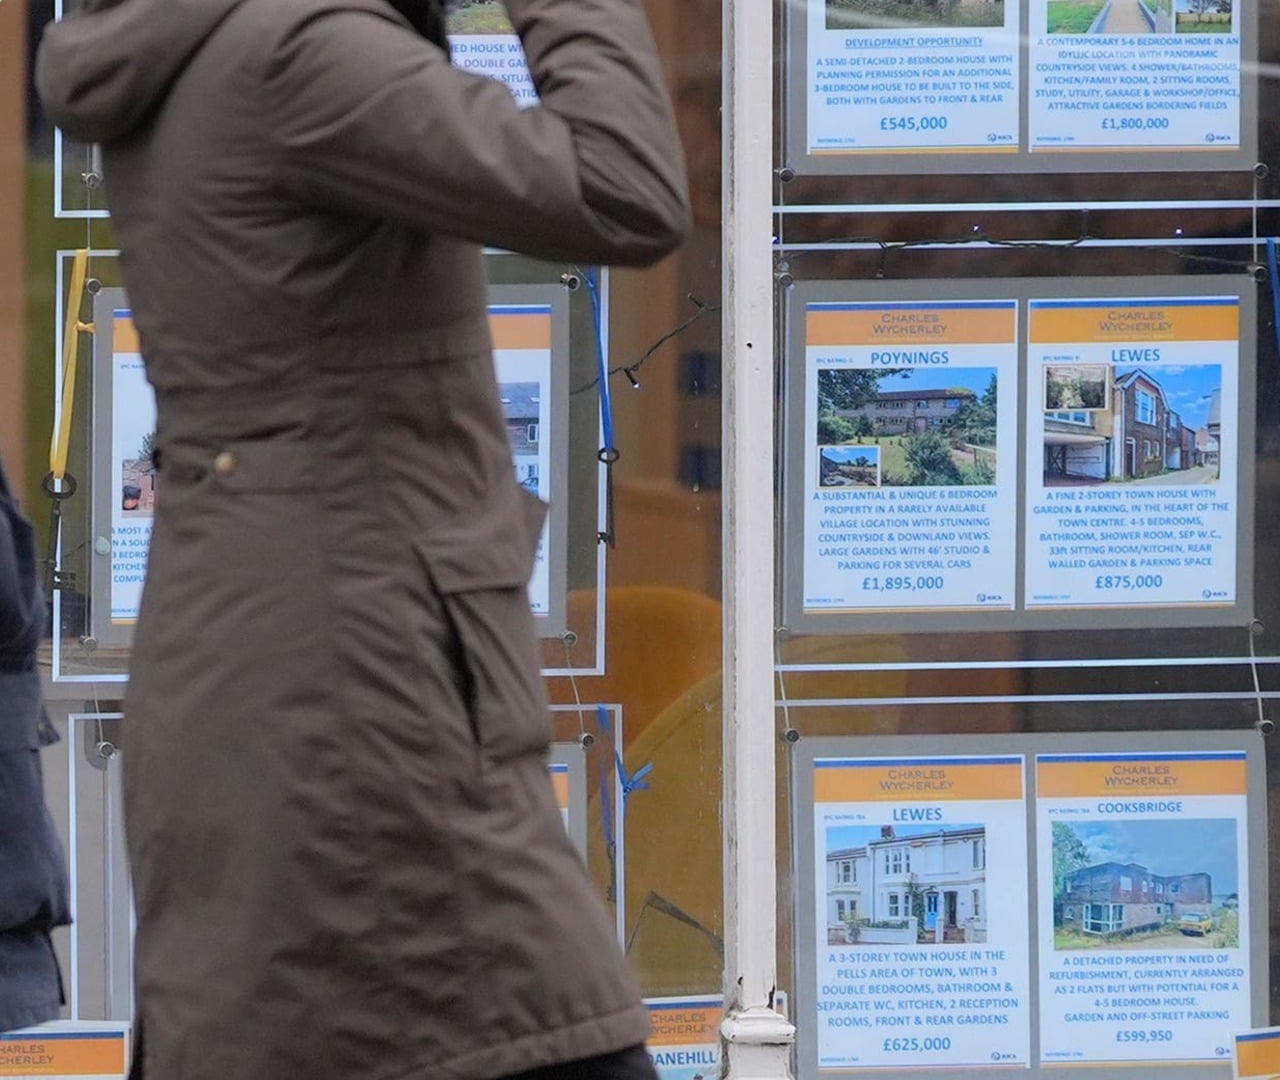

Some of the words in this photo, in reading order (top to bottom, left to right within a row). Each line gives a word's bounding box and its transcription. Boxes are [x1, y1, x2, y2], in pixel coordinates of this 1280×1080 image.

[845, 38, 914, 48] DEVELOPMENT
[917, 37, 982, 46] OPPORTUNITY
[880, 116, 947, 132] £545,000
[1102, 118, 1169, 130] £1,800,000
[882, 313, 938, 323] CHARLES
[1108, 311, 1164, 320] CHARLES
[873, 325, 947, 335] WYCHERLEY
[1100, 321, 1172, 332] WYCHERLEY
[871, 352, 949, 365] POYNINGS
[1112, 349, 1160, 362] LEWES
[824, 506, 872, 514] PROPERTY
[888, 505, 895, 513] A
[897, 504, 932, 513] RARELY
[935, 504, 986, 512] AVAILABLE
[863, 576, 943, 591] £1,895,000
[1096, 575, 1162, 590] £875,000
[1098, 802, 1182, 814] COOKSBRIDGE
[893, 808, 942, 821] LEWES
[829, 954, 836, 962] A
[839, 952, 890, 962] 3-STOREY
[894, 952, 928, 962] TOWN
[930, 951, 967, 962] HOUSE
[970, 951, 982, 960] IN
[985, 950, 1005, 960] THE
[1116, 1030, 1172, 1043] £599,950
[884, 1037, 951, 1052] £625,000
